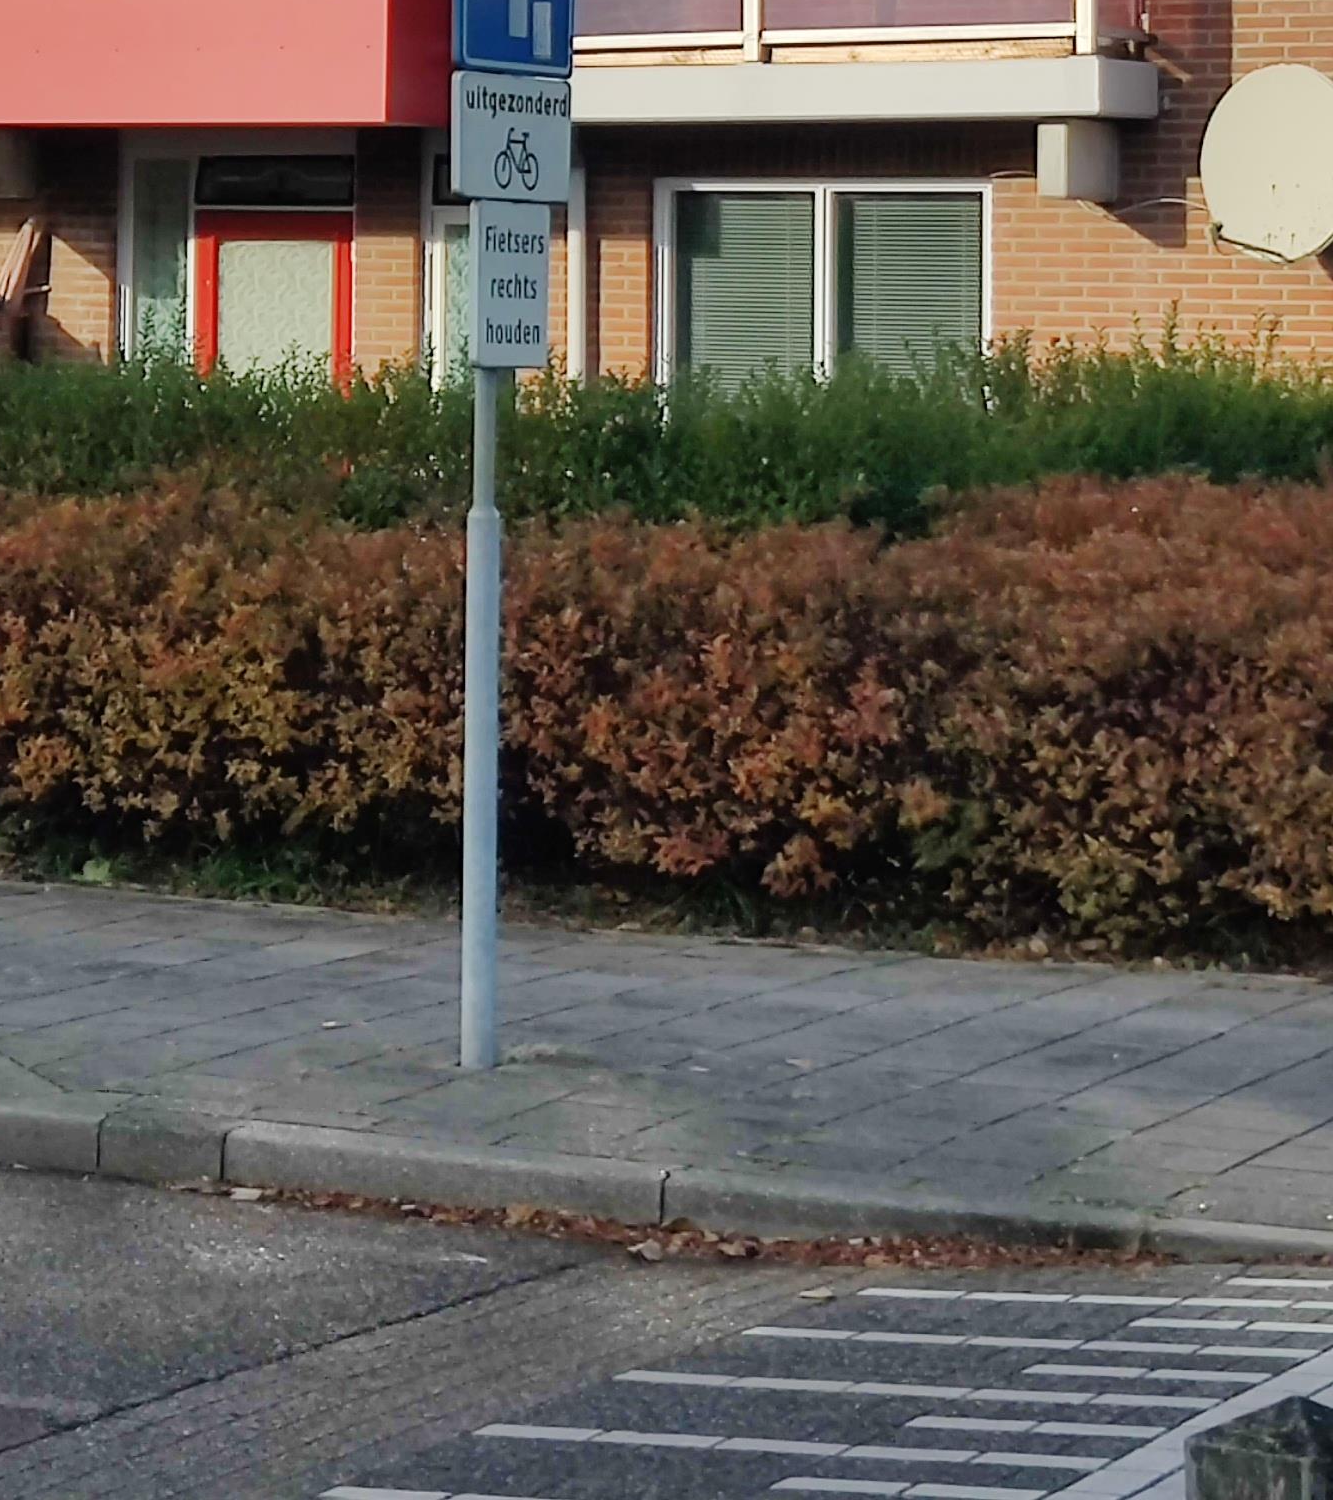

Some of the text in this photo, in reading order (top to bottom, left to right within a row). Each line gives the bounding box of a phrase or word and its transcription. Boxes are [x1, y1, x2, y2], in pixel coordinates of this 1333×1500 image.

[466, 85, 567, 119] uitgezonderd
[485, 226, 545, 255] Fietsers
[491, 273, 537, 300] rechts
[486, 318, 540, 345] houden
